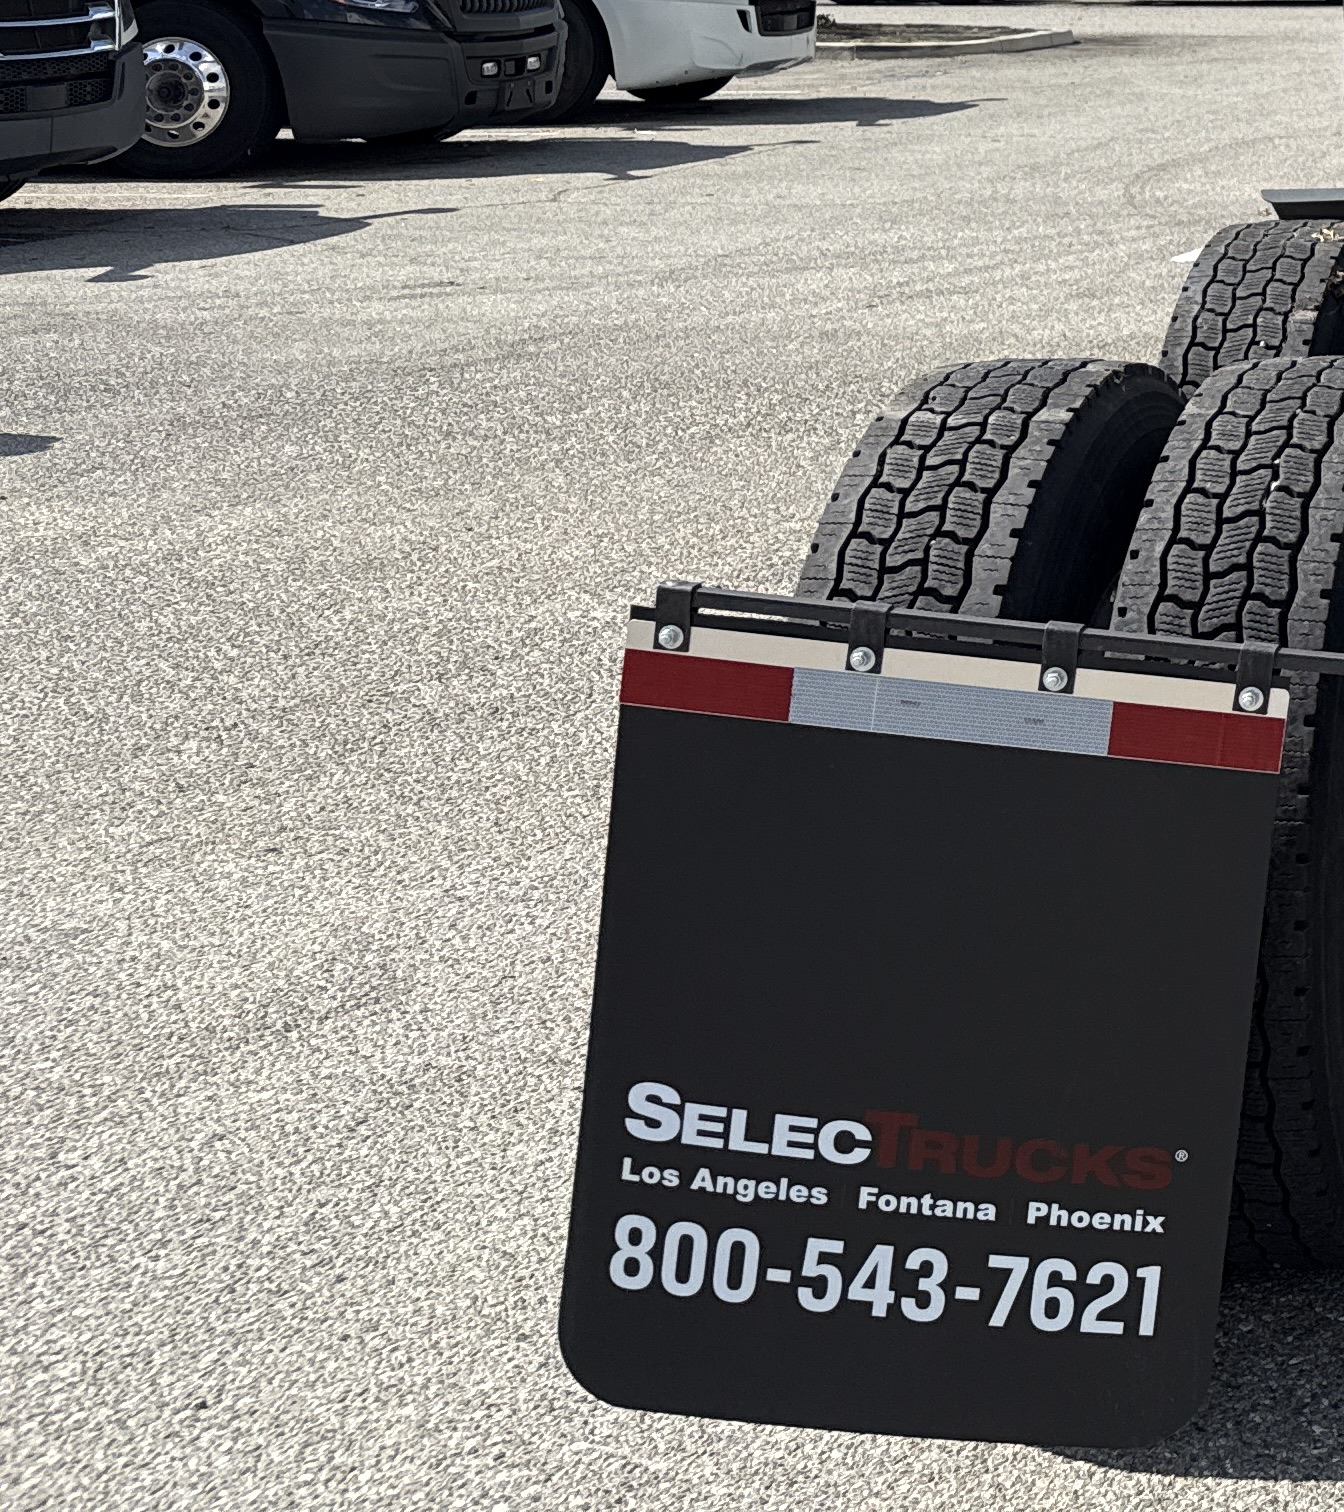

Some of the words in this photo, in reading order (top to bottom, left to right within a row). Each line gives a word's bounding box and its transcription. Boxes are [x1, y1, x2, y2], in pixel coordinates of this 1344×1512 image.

[621, 1156, 681, 1187] Los
[689, 1167, 829, 1206] Angeles
[857, 1185, 997, 1222] Fontana
[1026, 1201, 1166, 1234] Phoenix
[609, 1214, 1162, 1337] 800-543-7621
